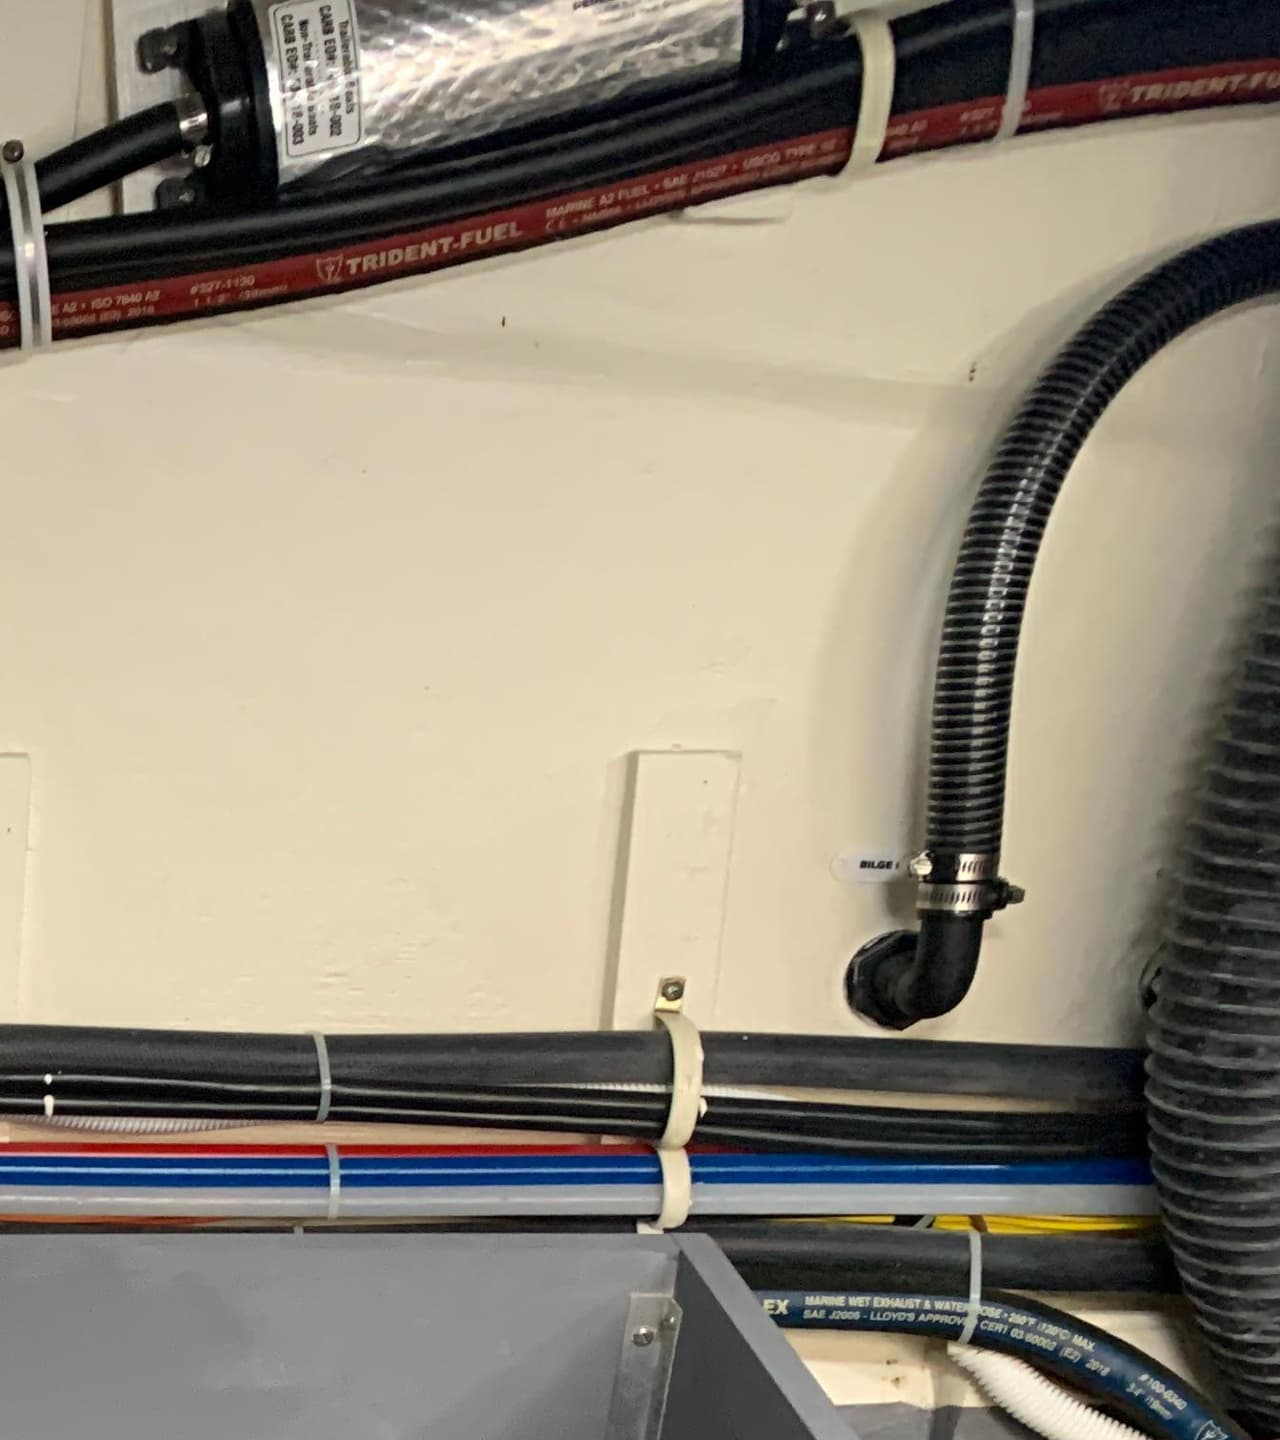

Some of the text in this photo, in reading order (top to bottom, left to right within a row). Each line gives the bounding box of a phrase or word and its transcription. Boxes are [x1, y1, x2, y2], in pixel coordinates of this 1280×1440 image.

[281, 14, 295, 44] CARB
[320, 5, 334, 35] CARB
[345, 220, 524, 277] TRIDENT-FUEL
[859, 860, 893, 869] BILGE
[805, 1296, 845, 1306] MARINE
[848, 1296, 871, 1307] WET
[873, 1296, 920, 1308] EXHAUST
[976, 1304, 1001, 1318] OSE
[803, 1310, 826, 1319] SAE
[870, 1310, 916, 1322] LLOYD'S
[1085, 1359, 1111, 1376] 2018
